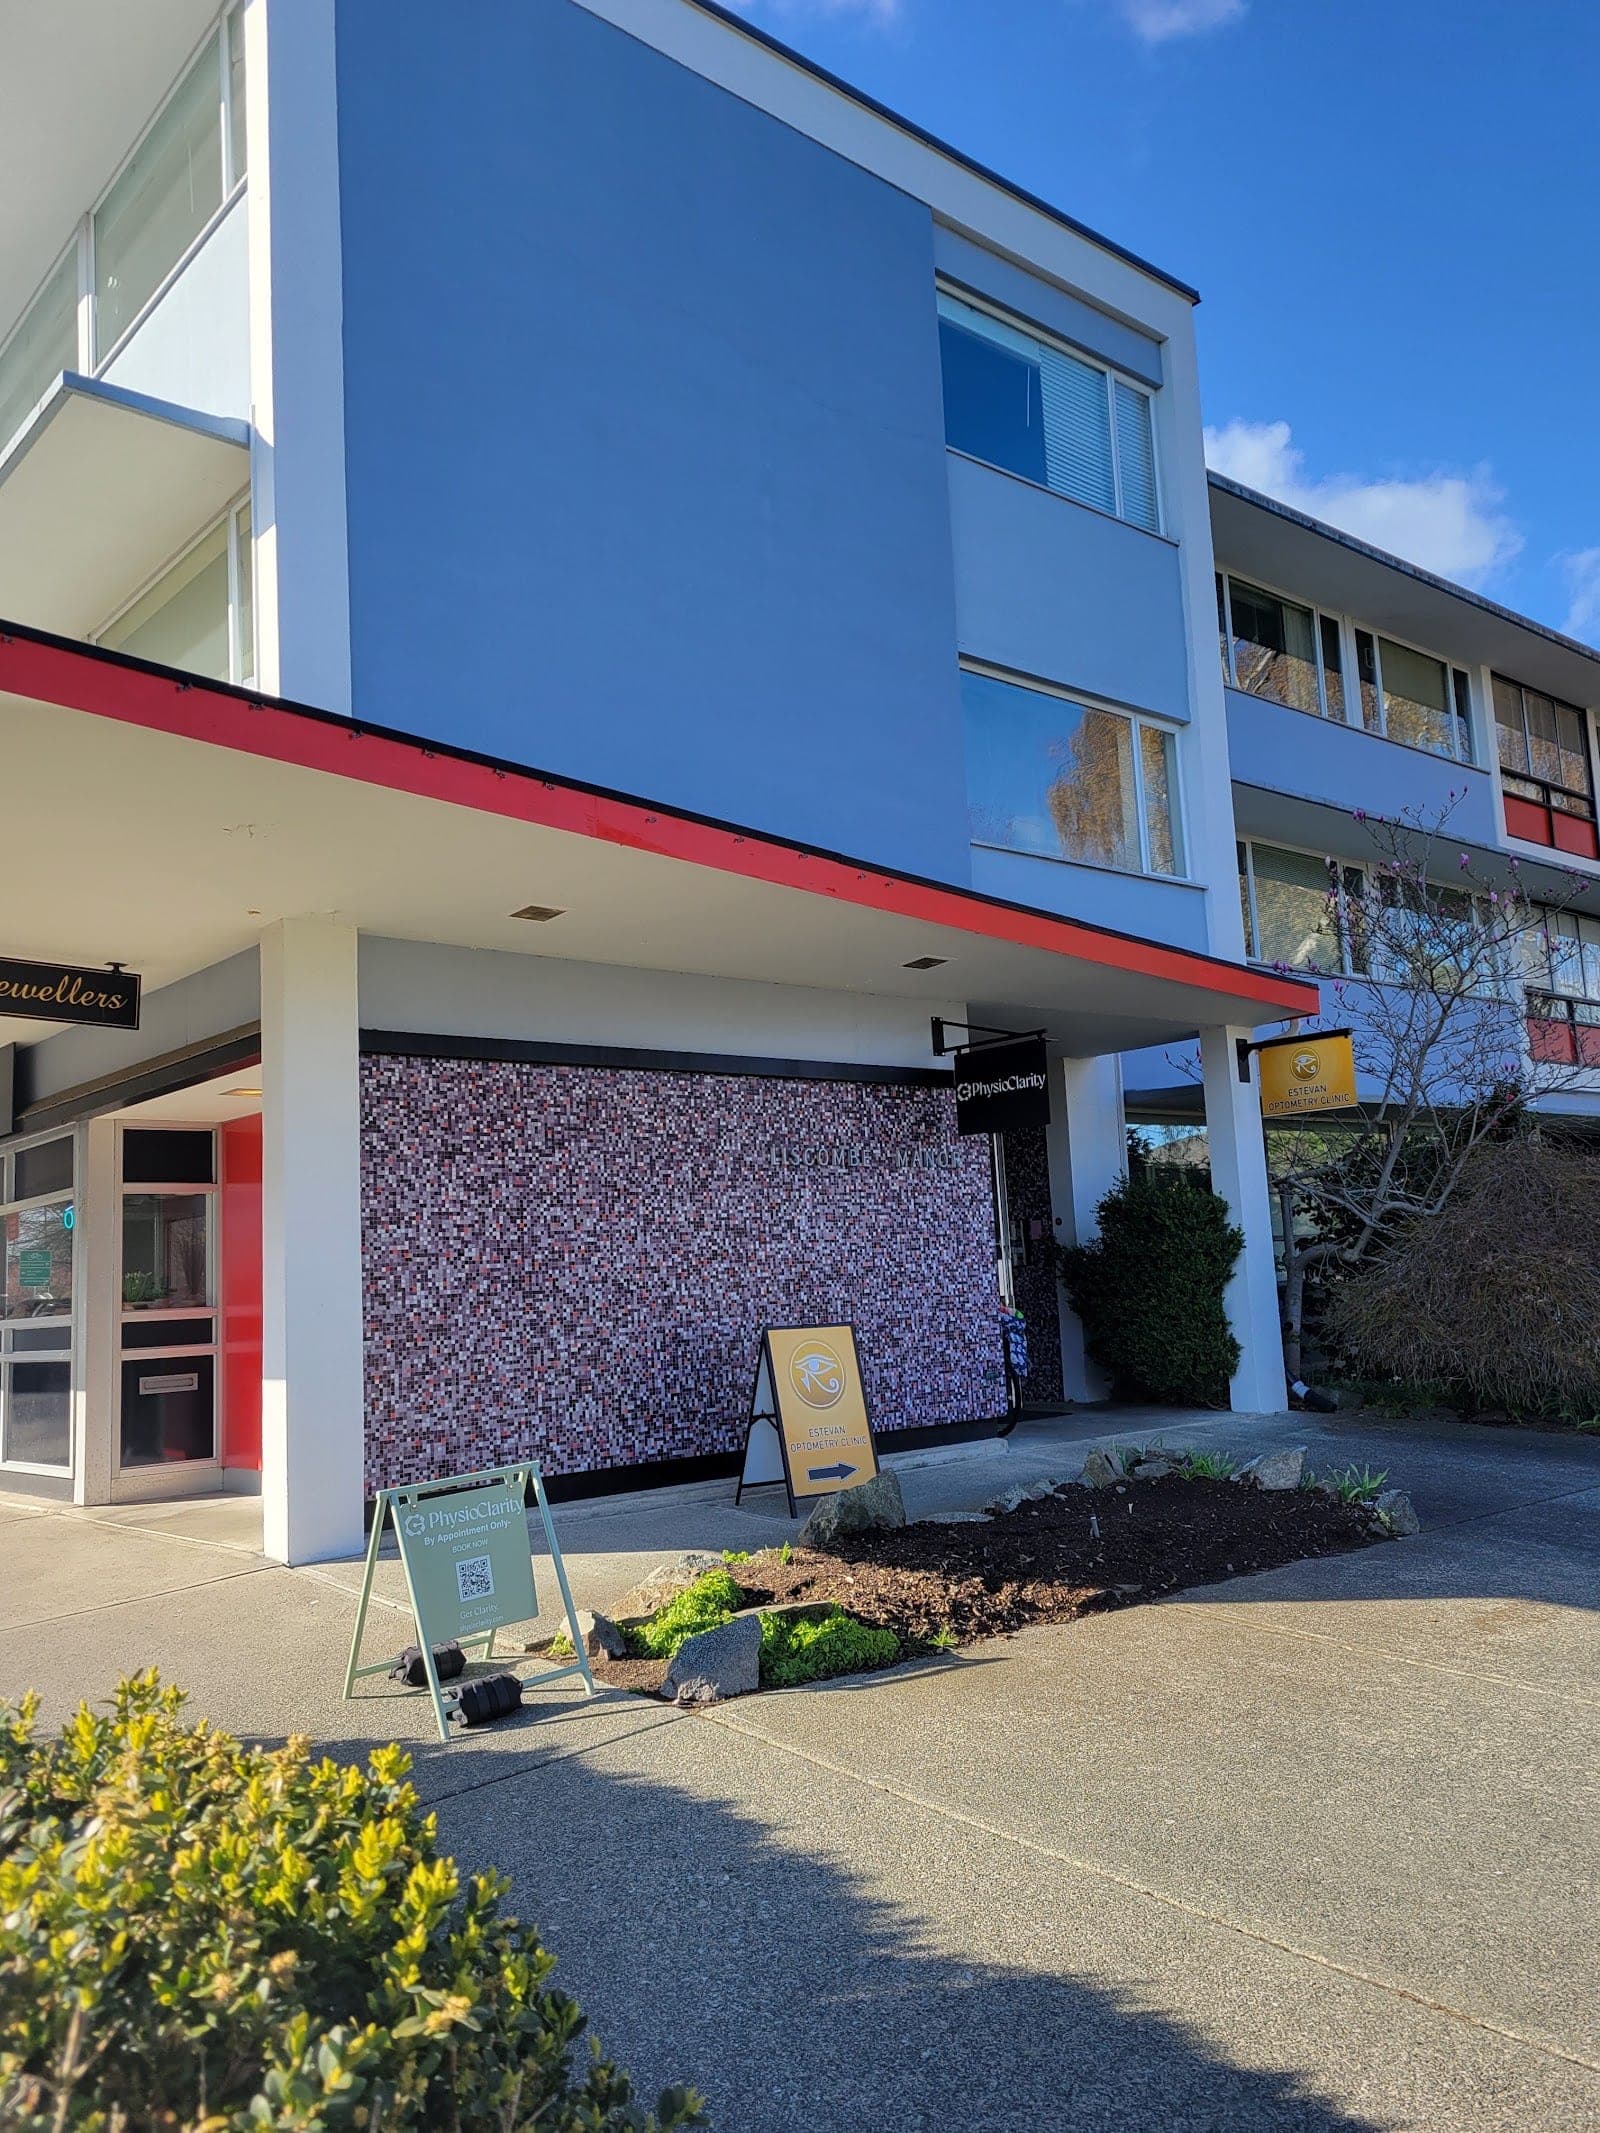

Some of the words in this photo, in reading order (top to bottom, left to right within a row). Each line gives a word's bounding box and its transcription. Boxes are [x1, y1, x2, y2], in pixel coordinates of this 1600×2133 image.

[972, 1072, 1046, 1098] PhysioClarity
[1288, 1085, 1327, 1097] ESTEVAN
[1268, 1097, 1318, 1111] OPTOMETRY
[1321, 1094, 1350, 1105] CLINIC
[769, 1147, 872, 1167] LISCOMBE
[896, 1149, 961, 1168] MANOR
[808, 1426, 846, 1438] ESTEVAN
[790, 1439, 838, 1453] OPTOMETRY
[841, 1435, 868, 1447] CLINIC
[429, 1497, 524, 1528] PhysioClarity
[424, 1536, 436, 1546] By
[438, 1525, 489, 1543] Appointment
[452, 1542, 472, 1554] BOOK
[472, 1538, 488, 1549] NOW
